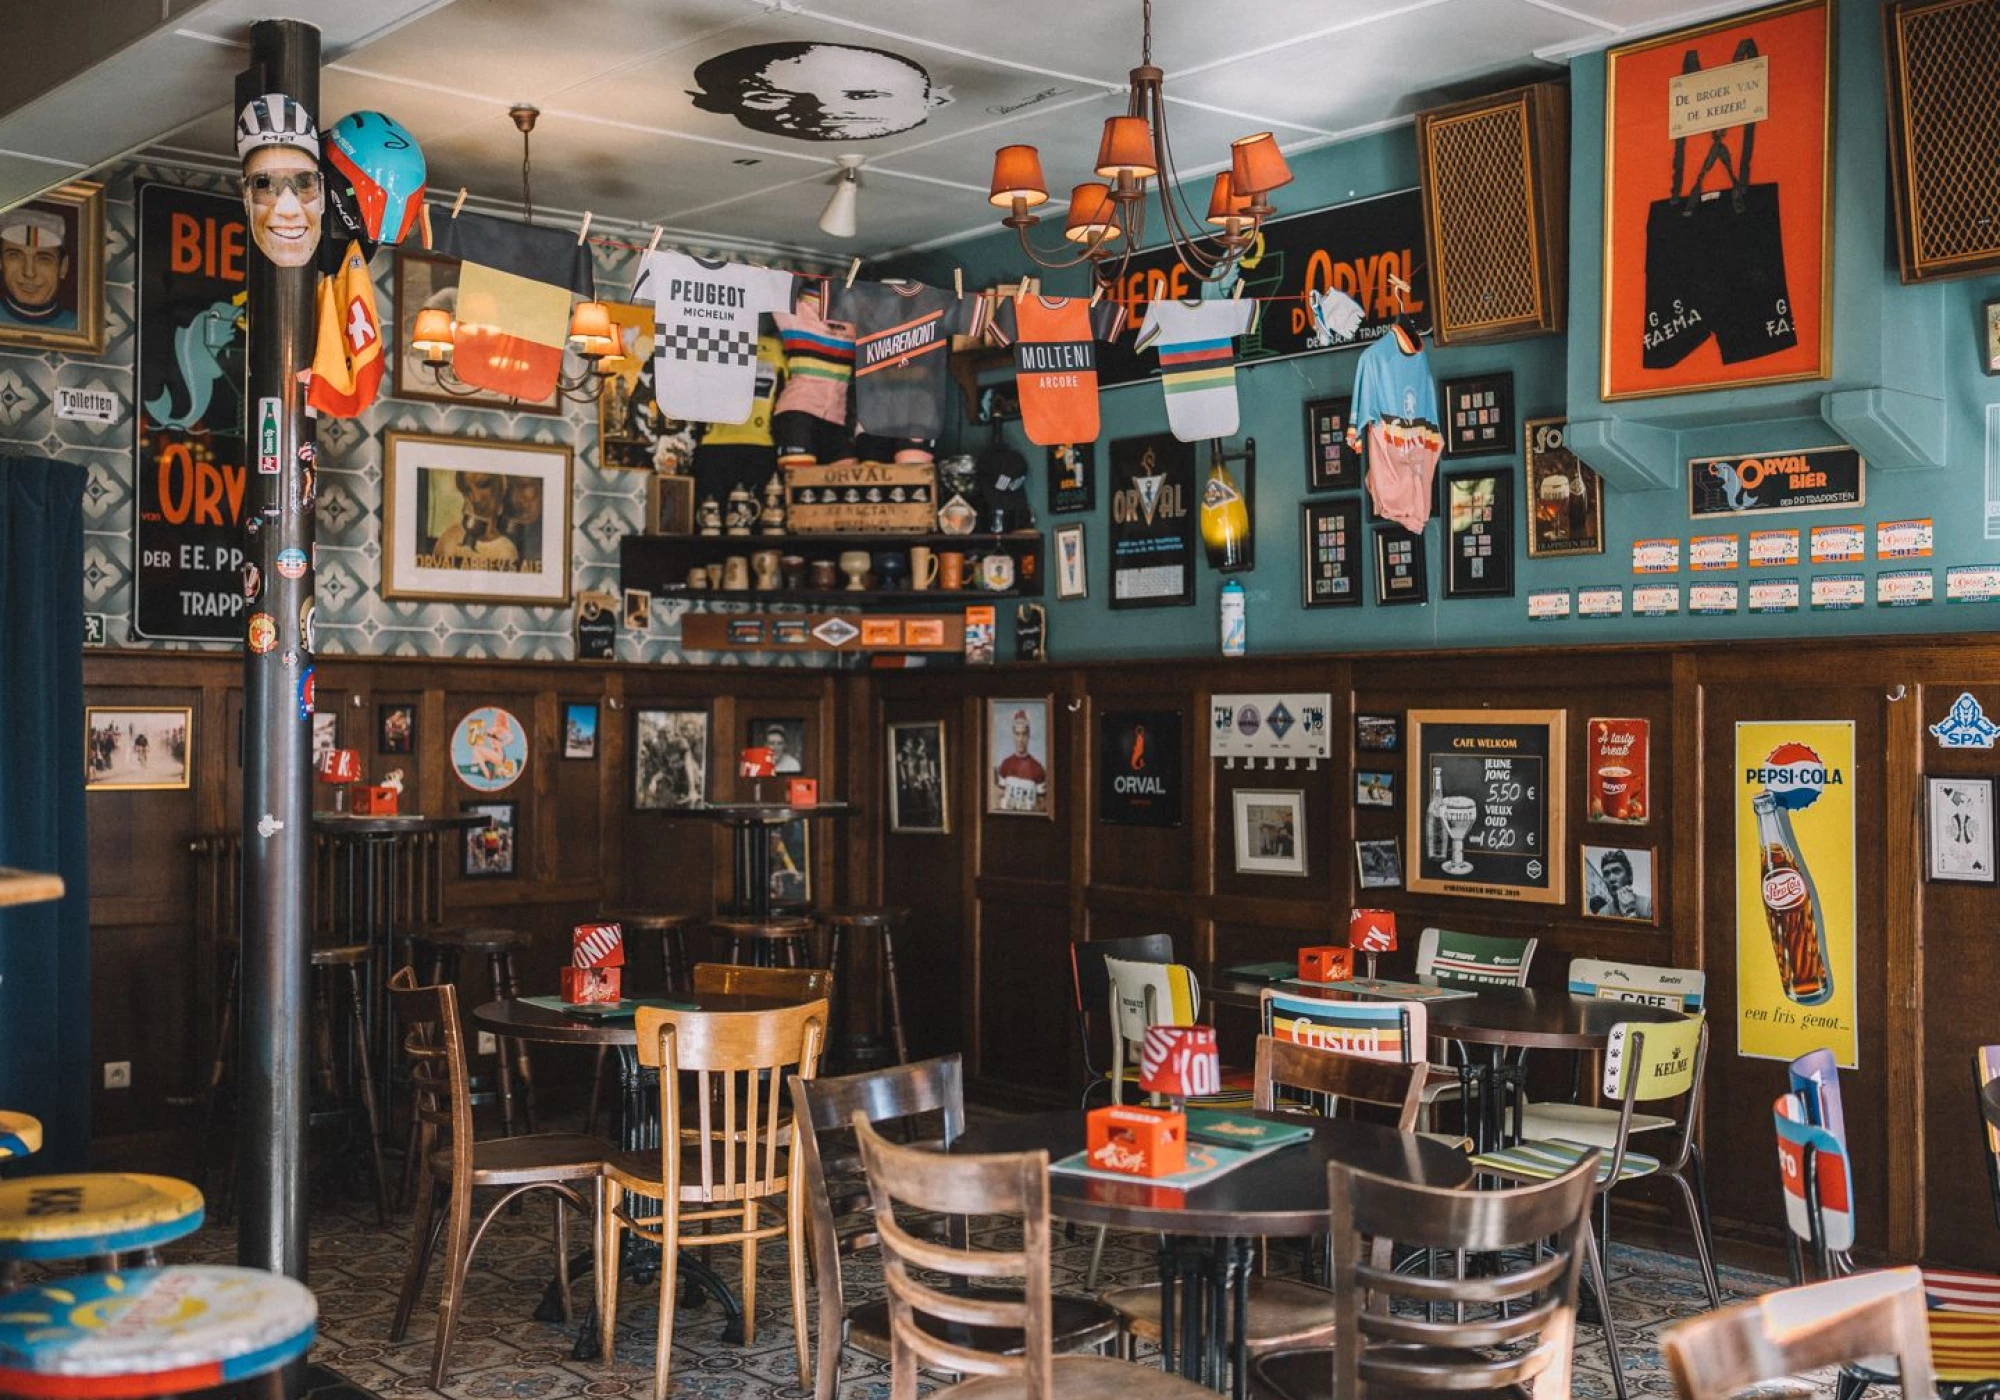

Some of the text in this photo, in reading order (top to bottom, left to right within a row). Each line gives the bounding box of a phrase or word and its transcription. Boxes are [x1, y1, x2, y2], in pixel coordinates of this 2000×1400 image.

[1676, 80, 1759, 106] DE BROEK VAN
[1688, 110, 1699, 121] DE
[670, 279, 746, 309] PEUGEOT
[683, 307, 735, 321] MICHELIN
[866, 320, 937, 364] KWAREMONT
[1022, 345, 1091, 369] MOLTENI
[1039, 375, 1079, 389] ARCORE
[60, 390, 112, 411] Toiletten
[823, 467, 893, 484] ORVAL
[1789, 472, 1827, 490] BIER
[1113, 473, 1188, 526] ORVAL
[143, 550, 172, 568] DER
[180, 545, 210, 570] EE.
[1453, 738, 1518, 749] CAFE WELKOM
[1947, 733, 1986, 746] SPA
[1484, 758, 1512, 769] JEUNE
[1484, 769, 1510, 782] JONG
[1113, 775, 1167, 795] ORVAL
[1486, 783, 1535, 803] 5,50 €
[1484, 805, 1513, 816] VIEUX
[1485, 816, 1508, 828] OUD
[1526, 832, 1535, 846] €
[1745, 1008, 1768, 1021] een
[1772, 1005, 1796, 1024] fris
